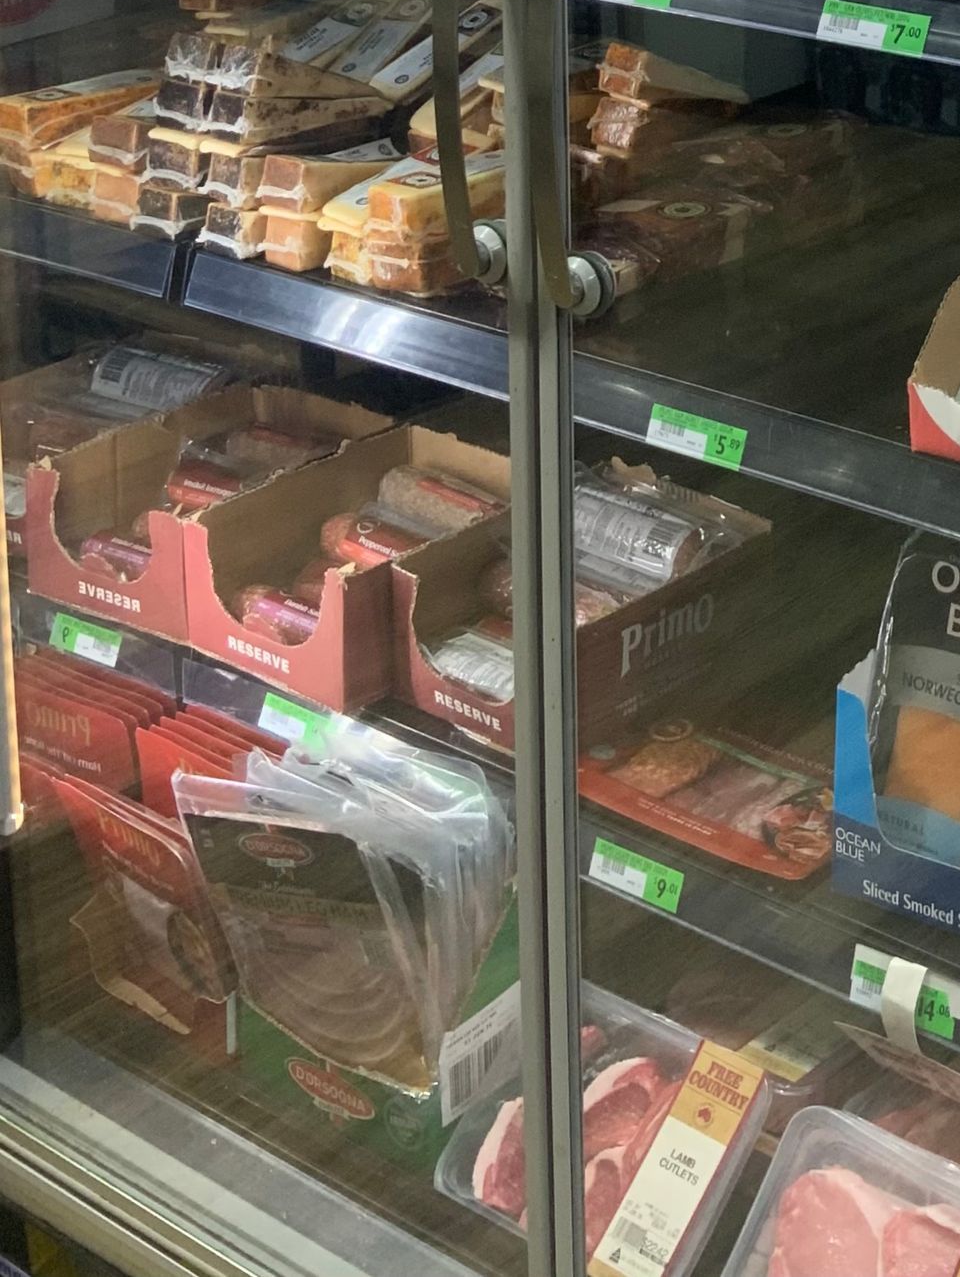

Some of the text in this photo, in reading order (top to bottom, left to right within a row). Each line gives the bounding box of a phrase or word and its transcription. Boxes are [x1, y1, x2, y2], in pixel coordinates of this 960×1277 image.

[891, 21, 921, 44] $7.00
[714, 433, 741, 455] $5.89
[620, 594, 714, 679] Primo
[228, 634, 290, 674] RESERVE
[434, 690, 502, 732] RESERVE
[835, 827, 881, 855] OCEAN
[835, 840, 865, 863] BLUE
[863, 880, 899, 906] Sliced
[903, 894, 954, 925] Smoked
[706, 1060, 744, 1090] FREE
[688, 1070, 750, 1111] COUNTRY
[659, 1157, 699, 1185] CUTLETS
[670, 1148, 696, 1168] LAMB
